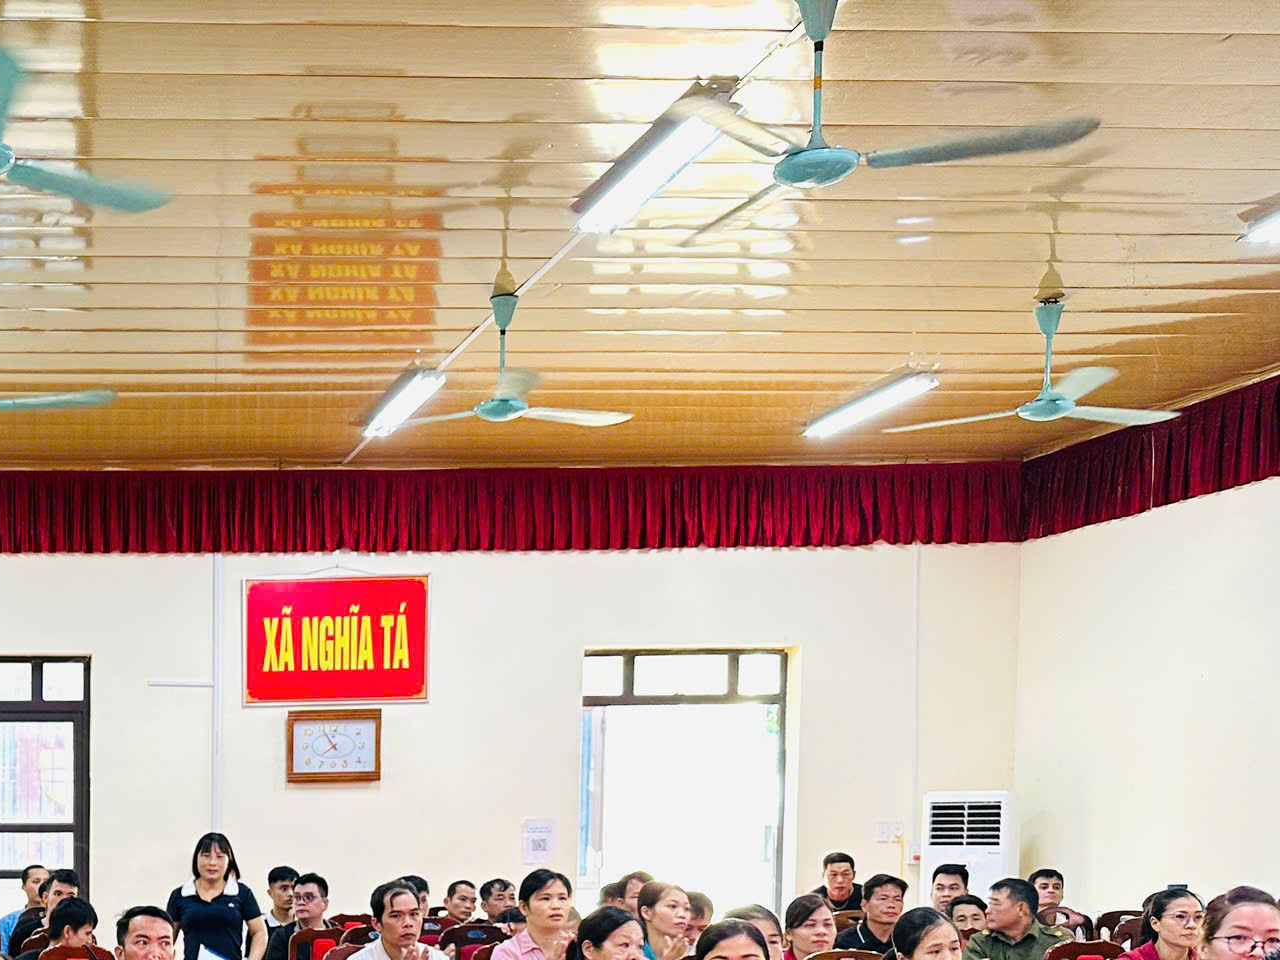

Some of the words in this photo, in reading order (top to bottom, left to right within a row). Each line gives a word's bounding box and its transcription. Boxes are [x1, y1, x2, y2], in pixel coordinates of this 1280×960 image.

[262, 605, 295, 672] XÃ
[301, 604, 375, 671] NGHĨA
[380, 602, 410, 670] TÁ
